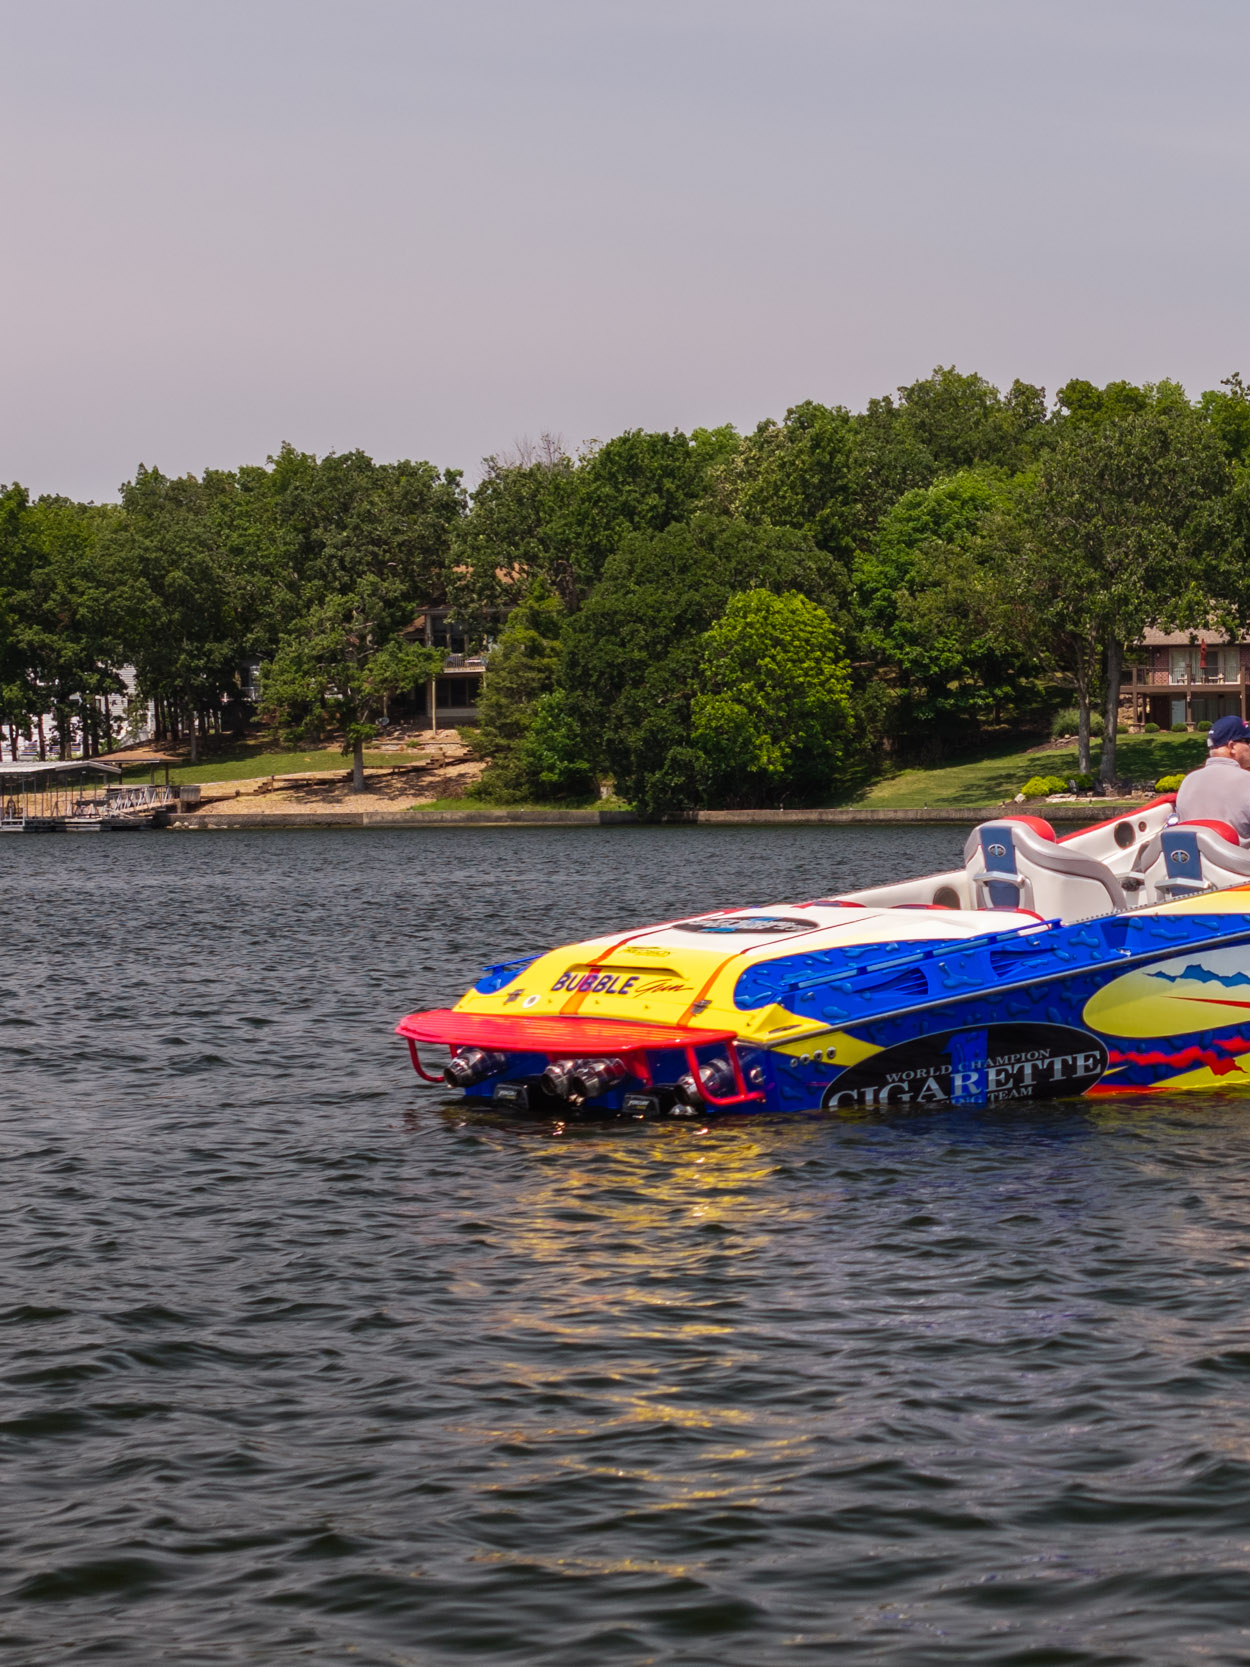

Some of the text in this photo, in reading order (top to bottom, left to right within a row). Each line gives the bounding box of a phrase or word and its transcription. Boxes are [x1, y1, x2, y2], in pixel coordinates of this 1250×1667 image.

[551, 971, 640, 995] BUBBLE
[828, 1051, 1101, 1107] CIGARETTE
[886, 1049, 1050, 1082] WORLD CHAMPION
[987, 1087, 1033, 1103] TEAM
